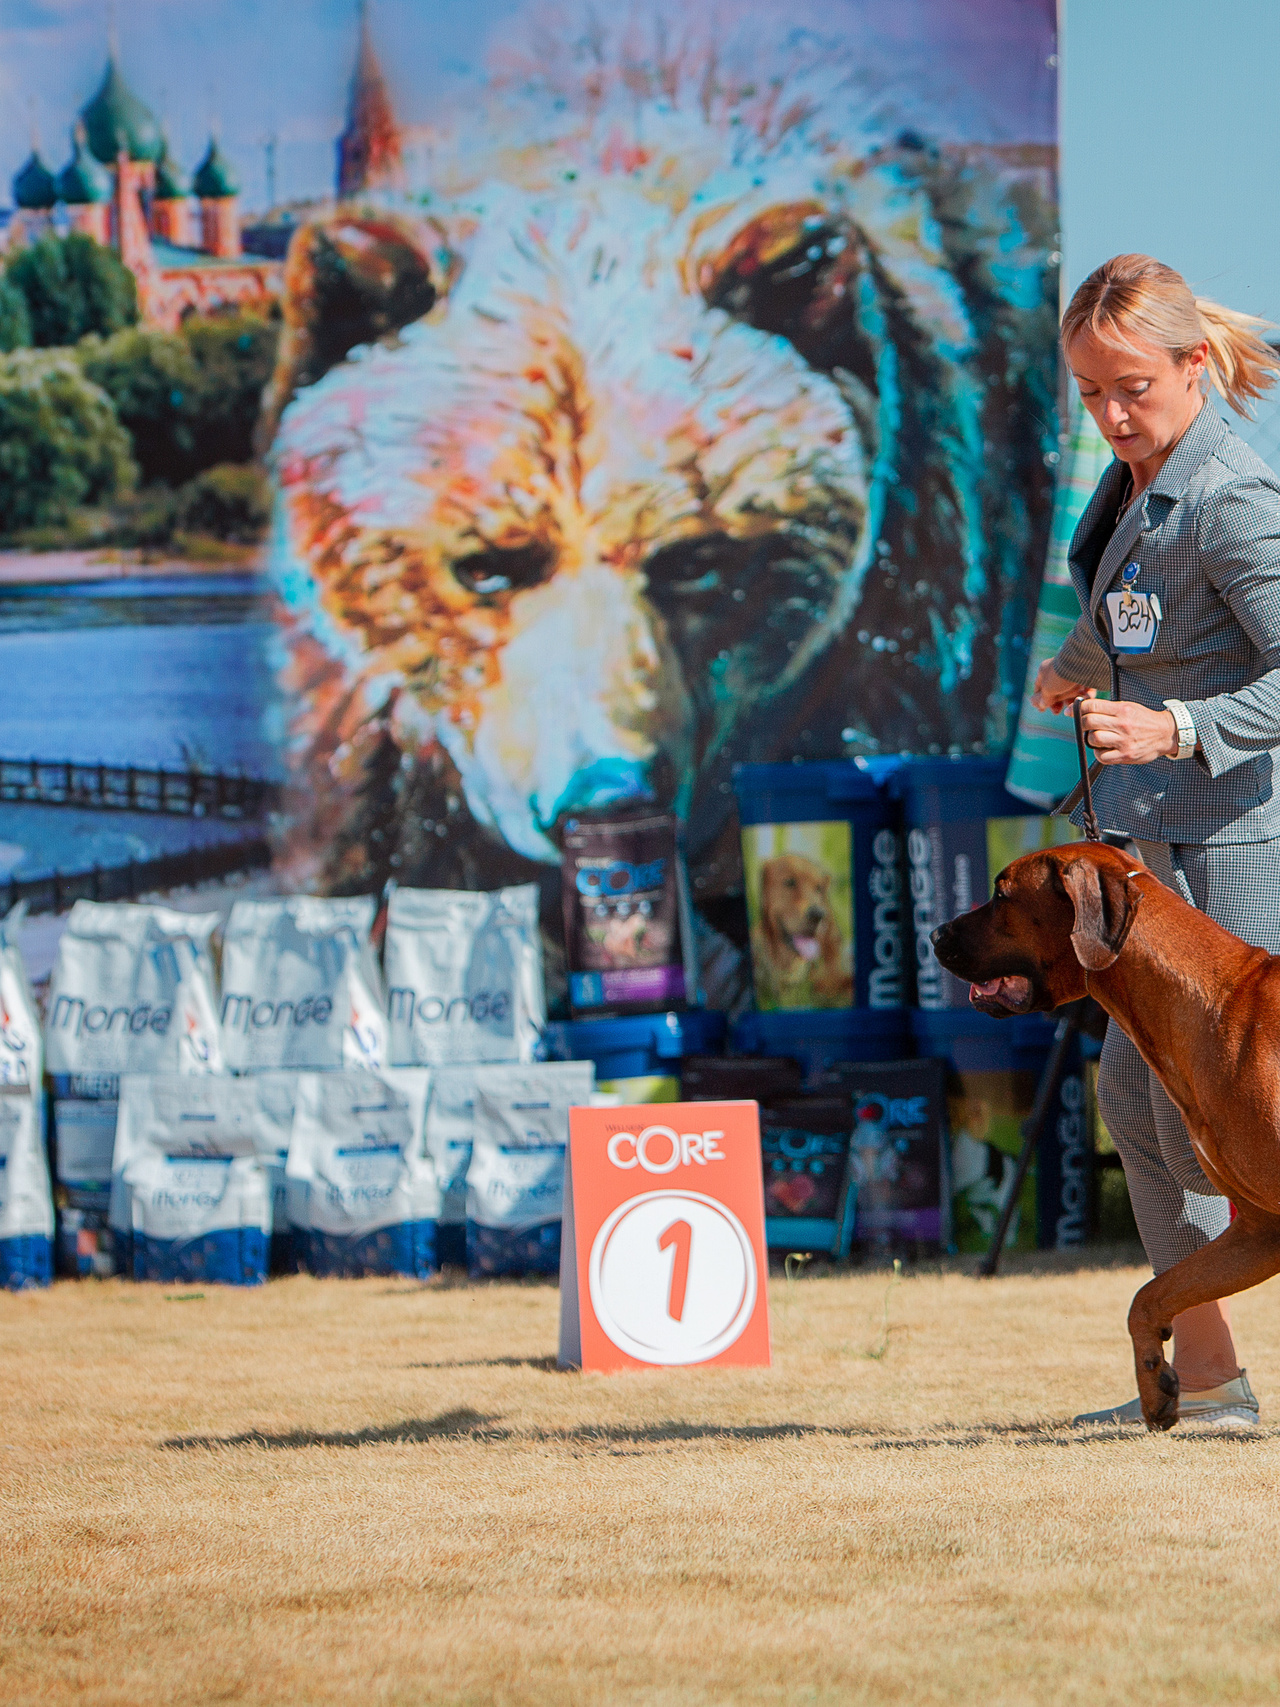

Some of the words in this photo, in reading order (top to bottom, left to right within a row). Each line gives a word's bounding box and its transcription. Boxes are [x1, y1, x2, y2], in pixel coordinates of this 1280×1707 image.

[1118, 599, 1152, 633] 524
[607, 1124, 727, 1174] CORE
[657, 1217, 693, 1323] 1
